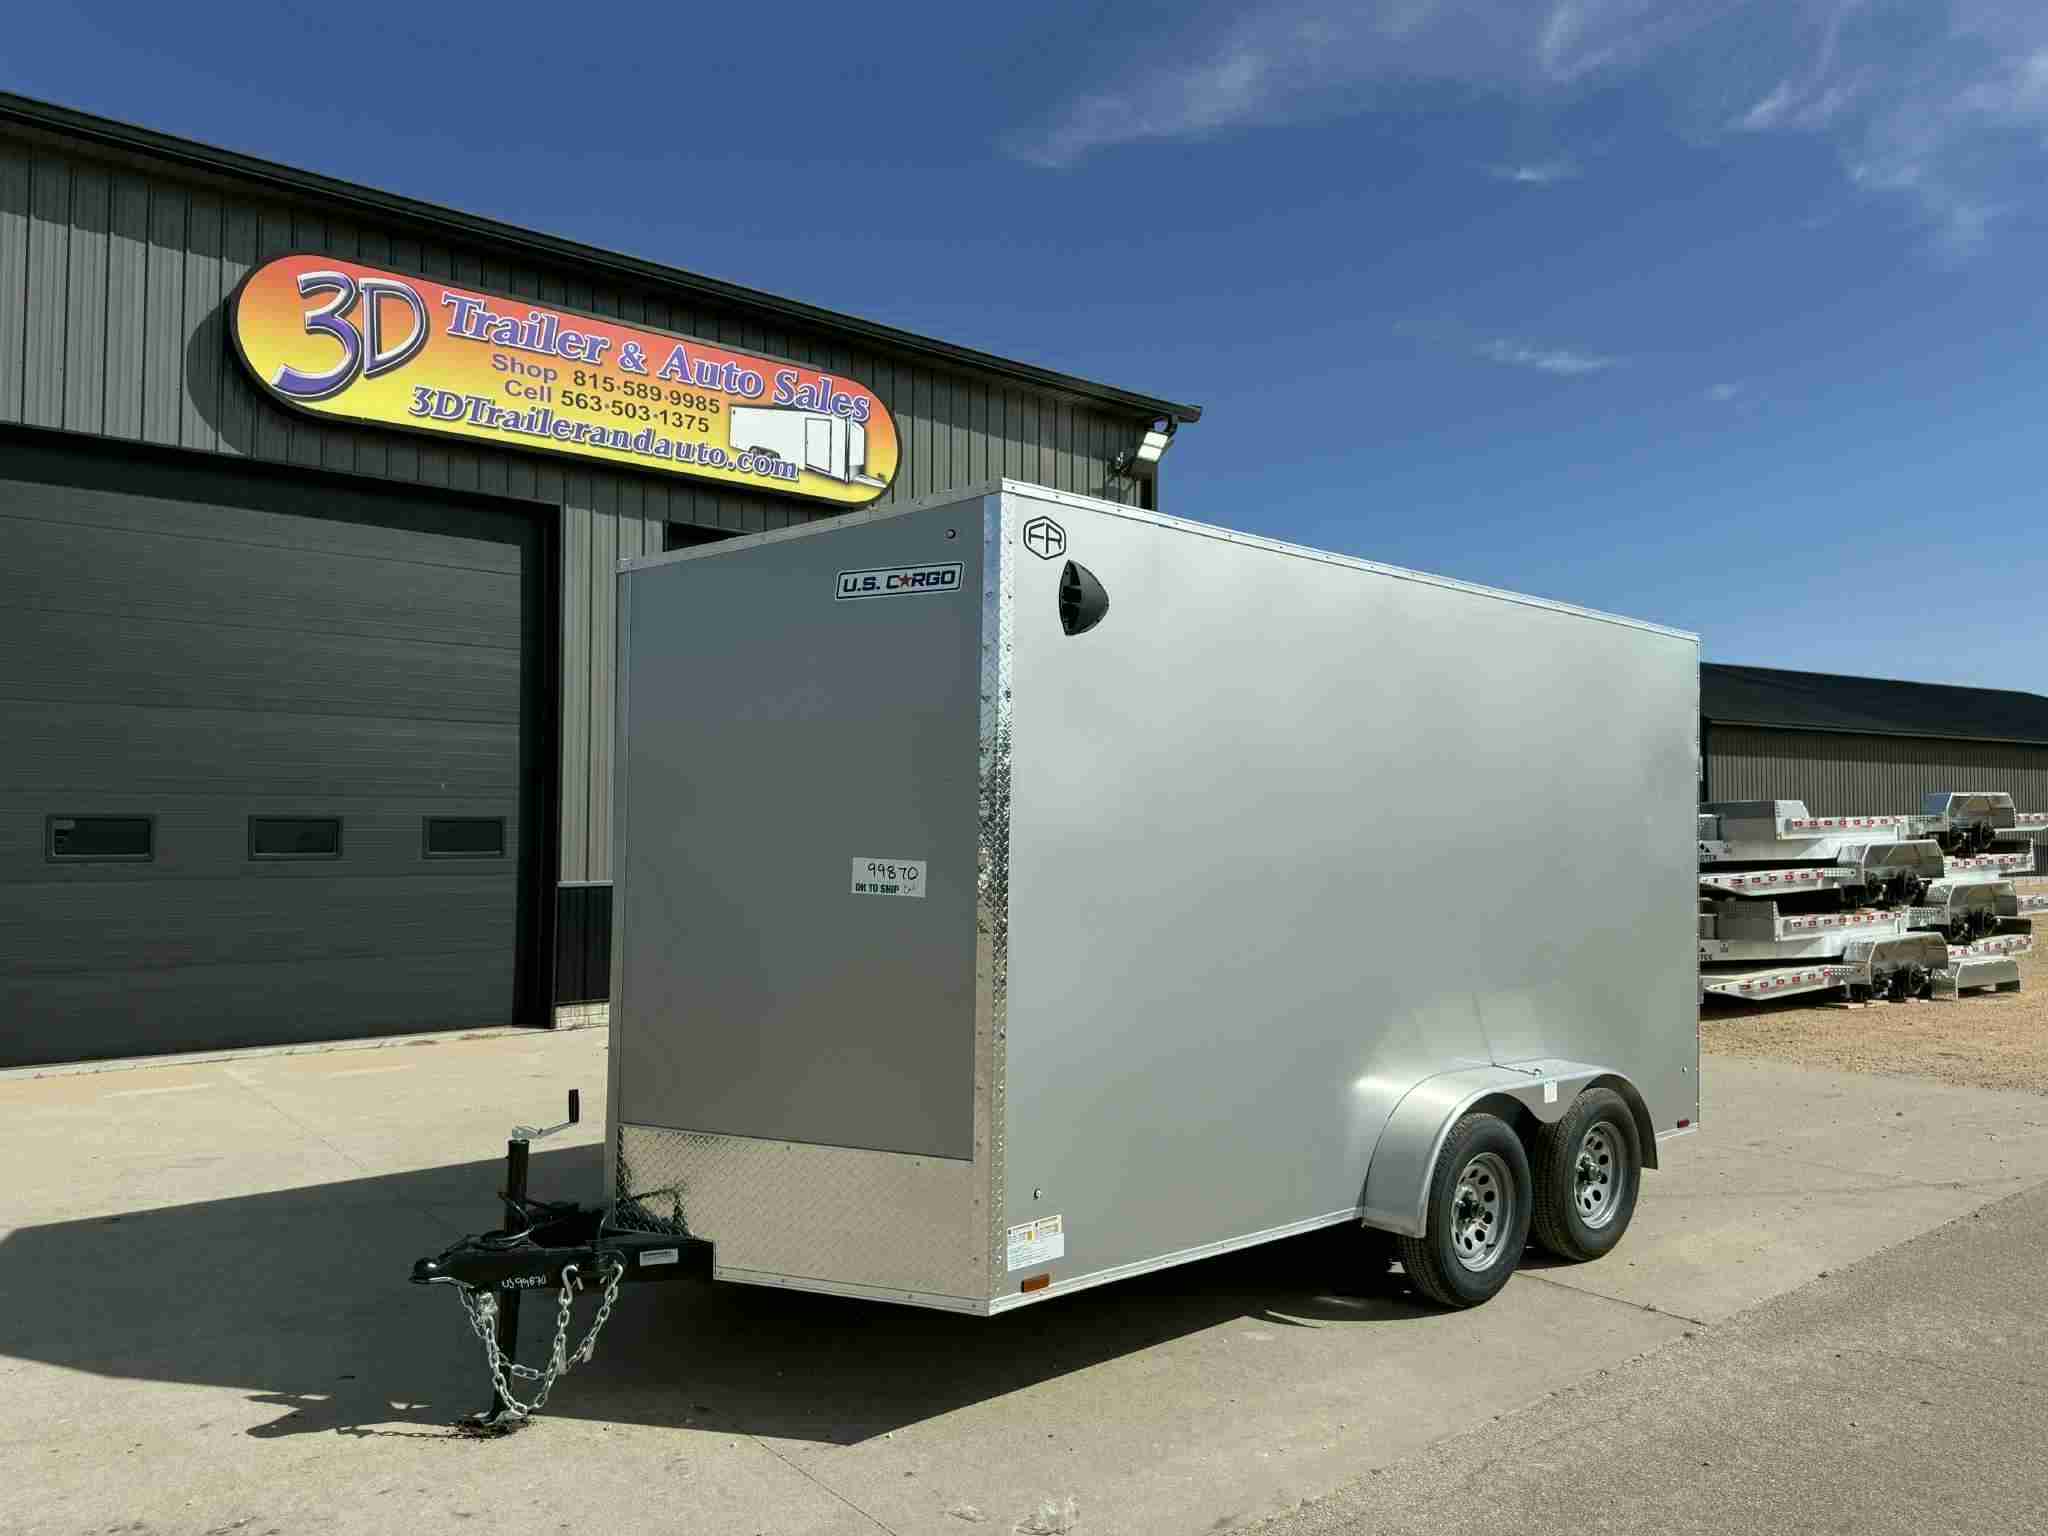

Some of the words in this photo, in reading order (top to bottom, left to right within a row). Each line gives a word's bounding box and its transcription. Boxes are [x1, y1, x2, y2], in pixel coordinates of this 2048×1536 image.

[271, 271, 428, 398] 3D
[442, 292, 609, 366] Trailer
[618, 342, 648, 374] &
[658, 344, 764, 398] Auto
[772, 369, 871, 422] Sales
[491, 353, 558, 383] Shop
[504, 379, 551, 404] Cell
[409, 385, 800, 481] 3DTrailerandauto.com
[843, 577, 881, 592] U.S.
[867, 862, 919, 881] 99870
